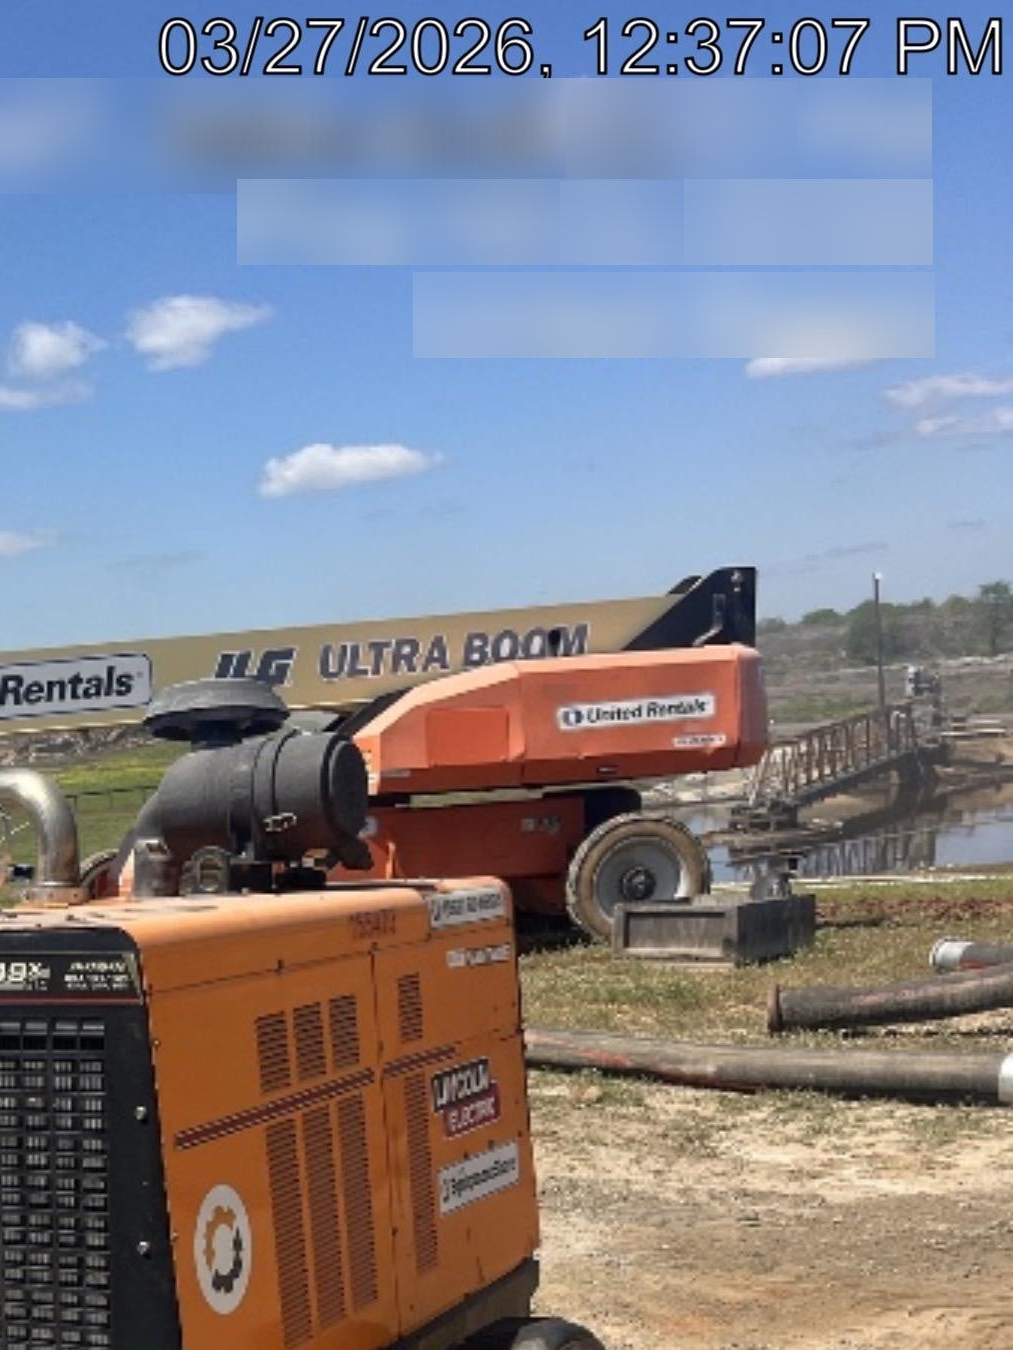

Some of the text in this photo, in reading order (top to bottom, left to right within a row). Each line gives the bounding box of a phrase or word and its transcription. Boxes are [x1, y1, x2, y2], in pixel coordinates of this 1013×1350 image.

[320, 635, 449, 679] ULTRA
[463, 624, 589, 668] BOOM
[588, 698, 706, 723] United Rentals
